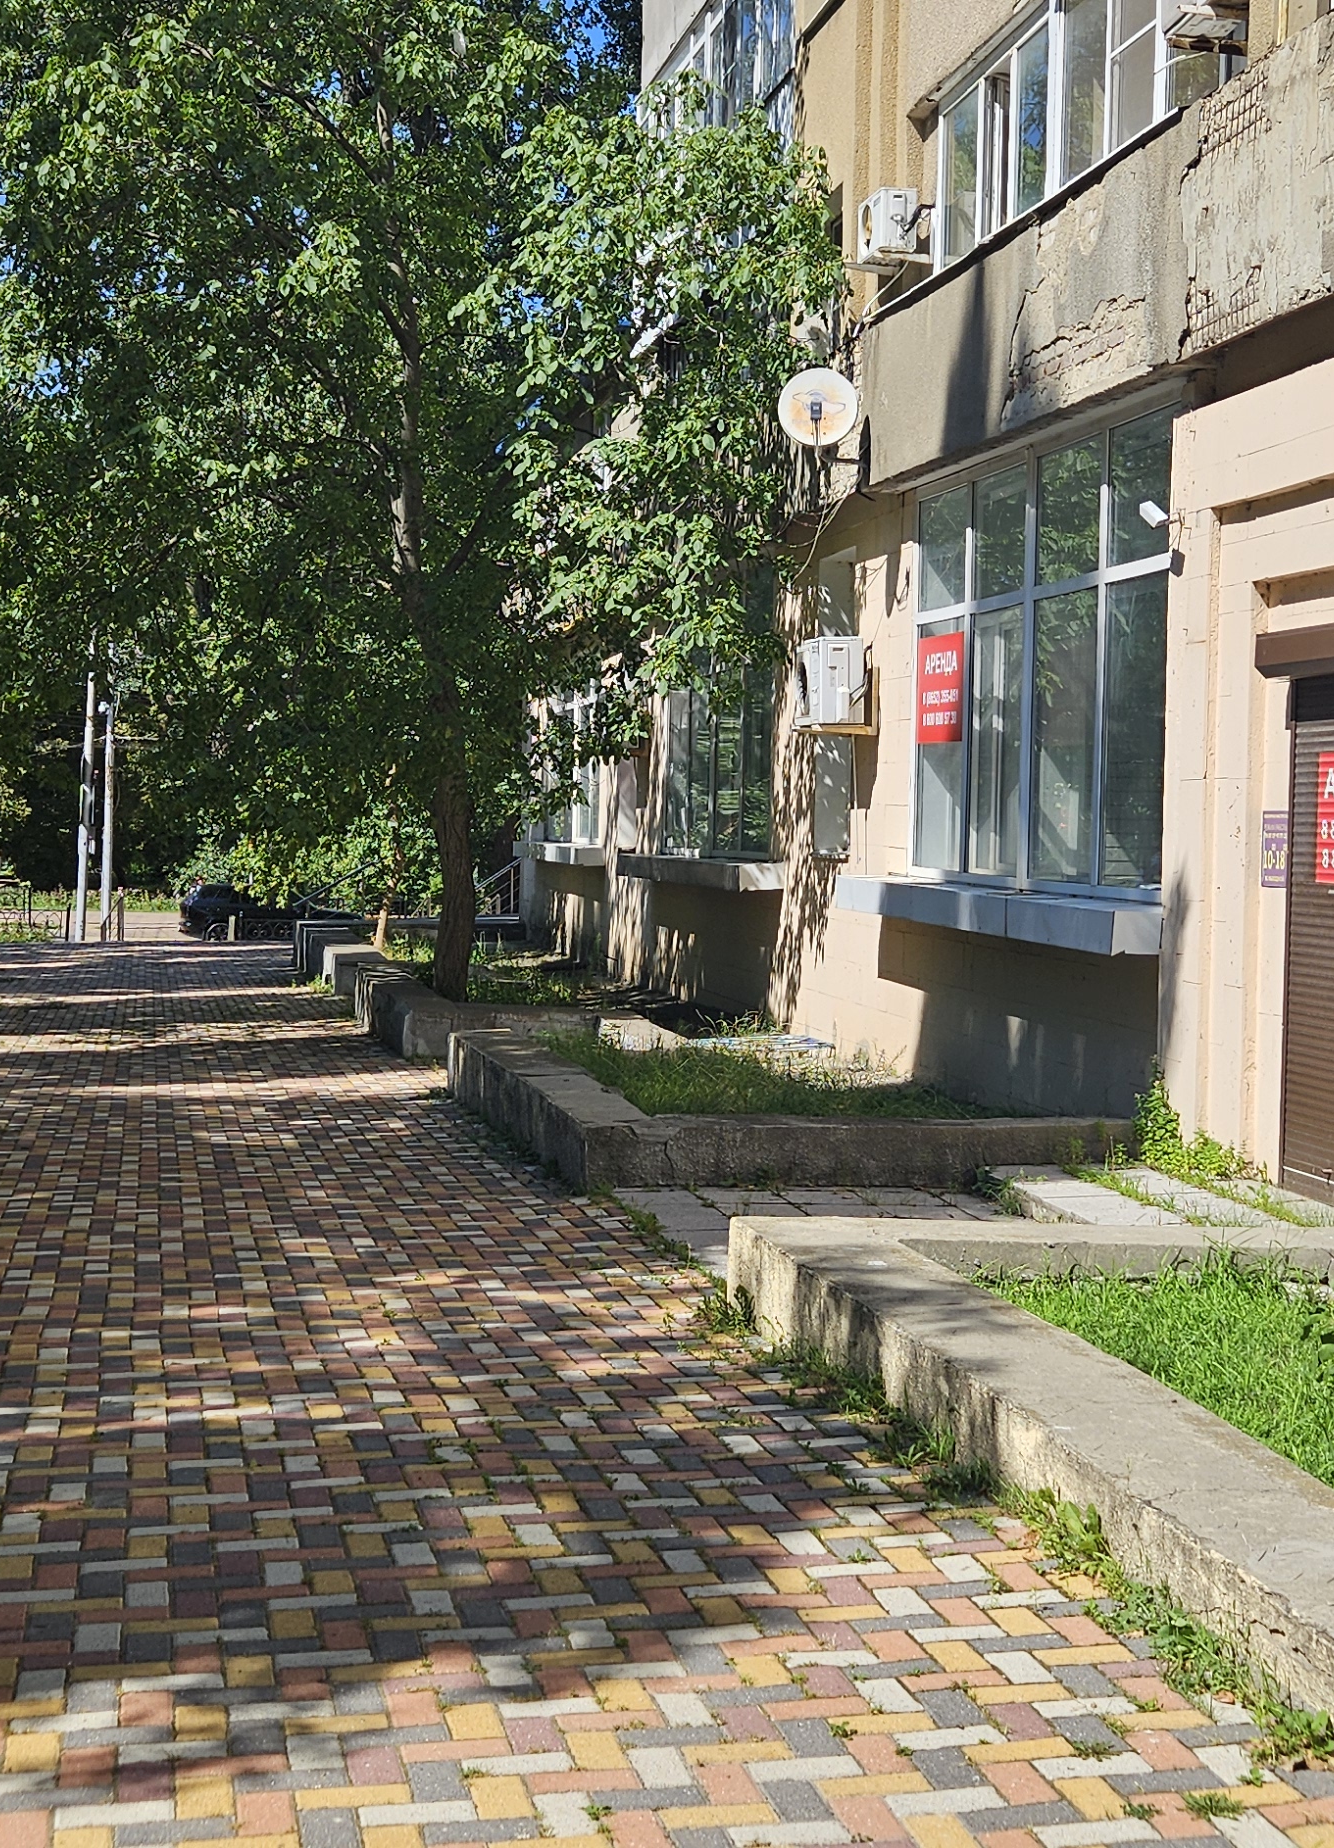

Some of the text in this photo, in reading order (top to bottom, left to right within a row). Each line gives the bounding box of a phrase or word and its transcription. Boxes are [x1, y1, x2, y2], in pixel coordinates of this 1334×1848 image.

[925, 651, 958, 676] АРЕНДА
[1321, 820, 1329, 840] 8
[1322, 849, 1329, 869] 8
